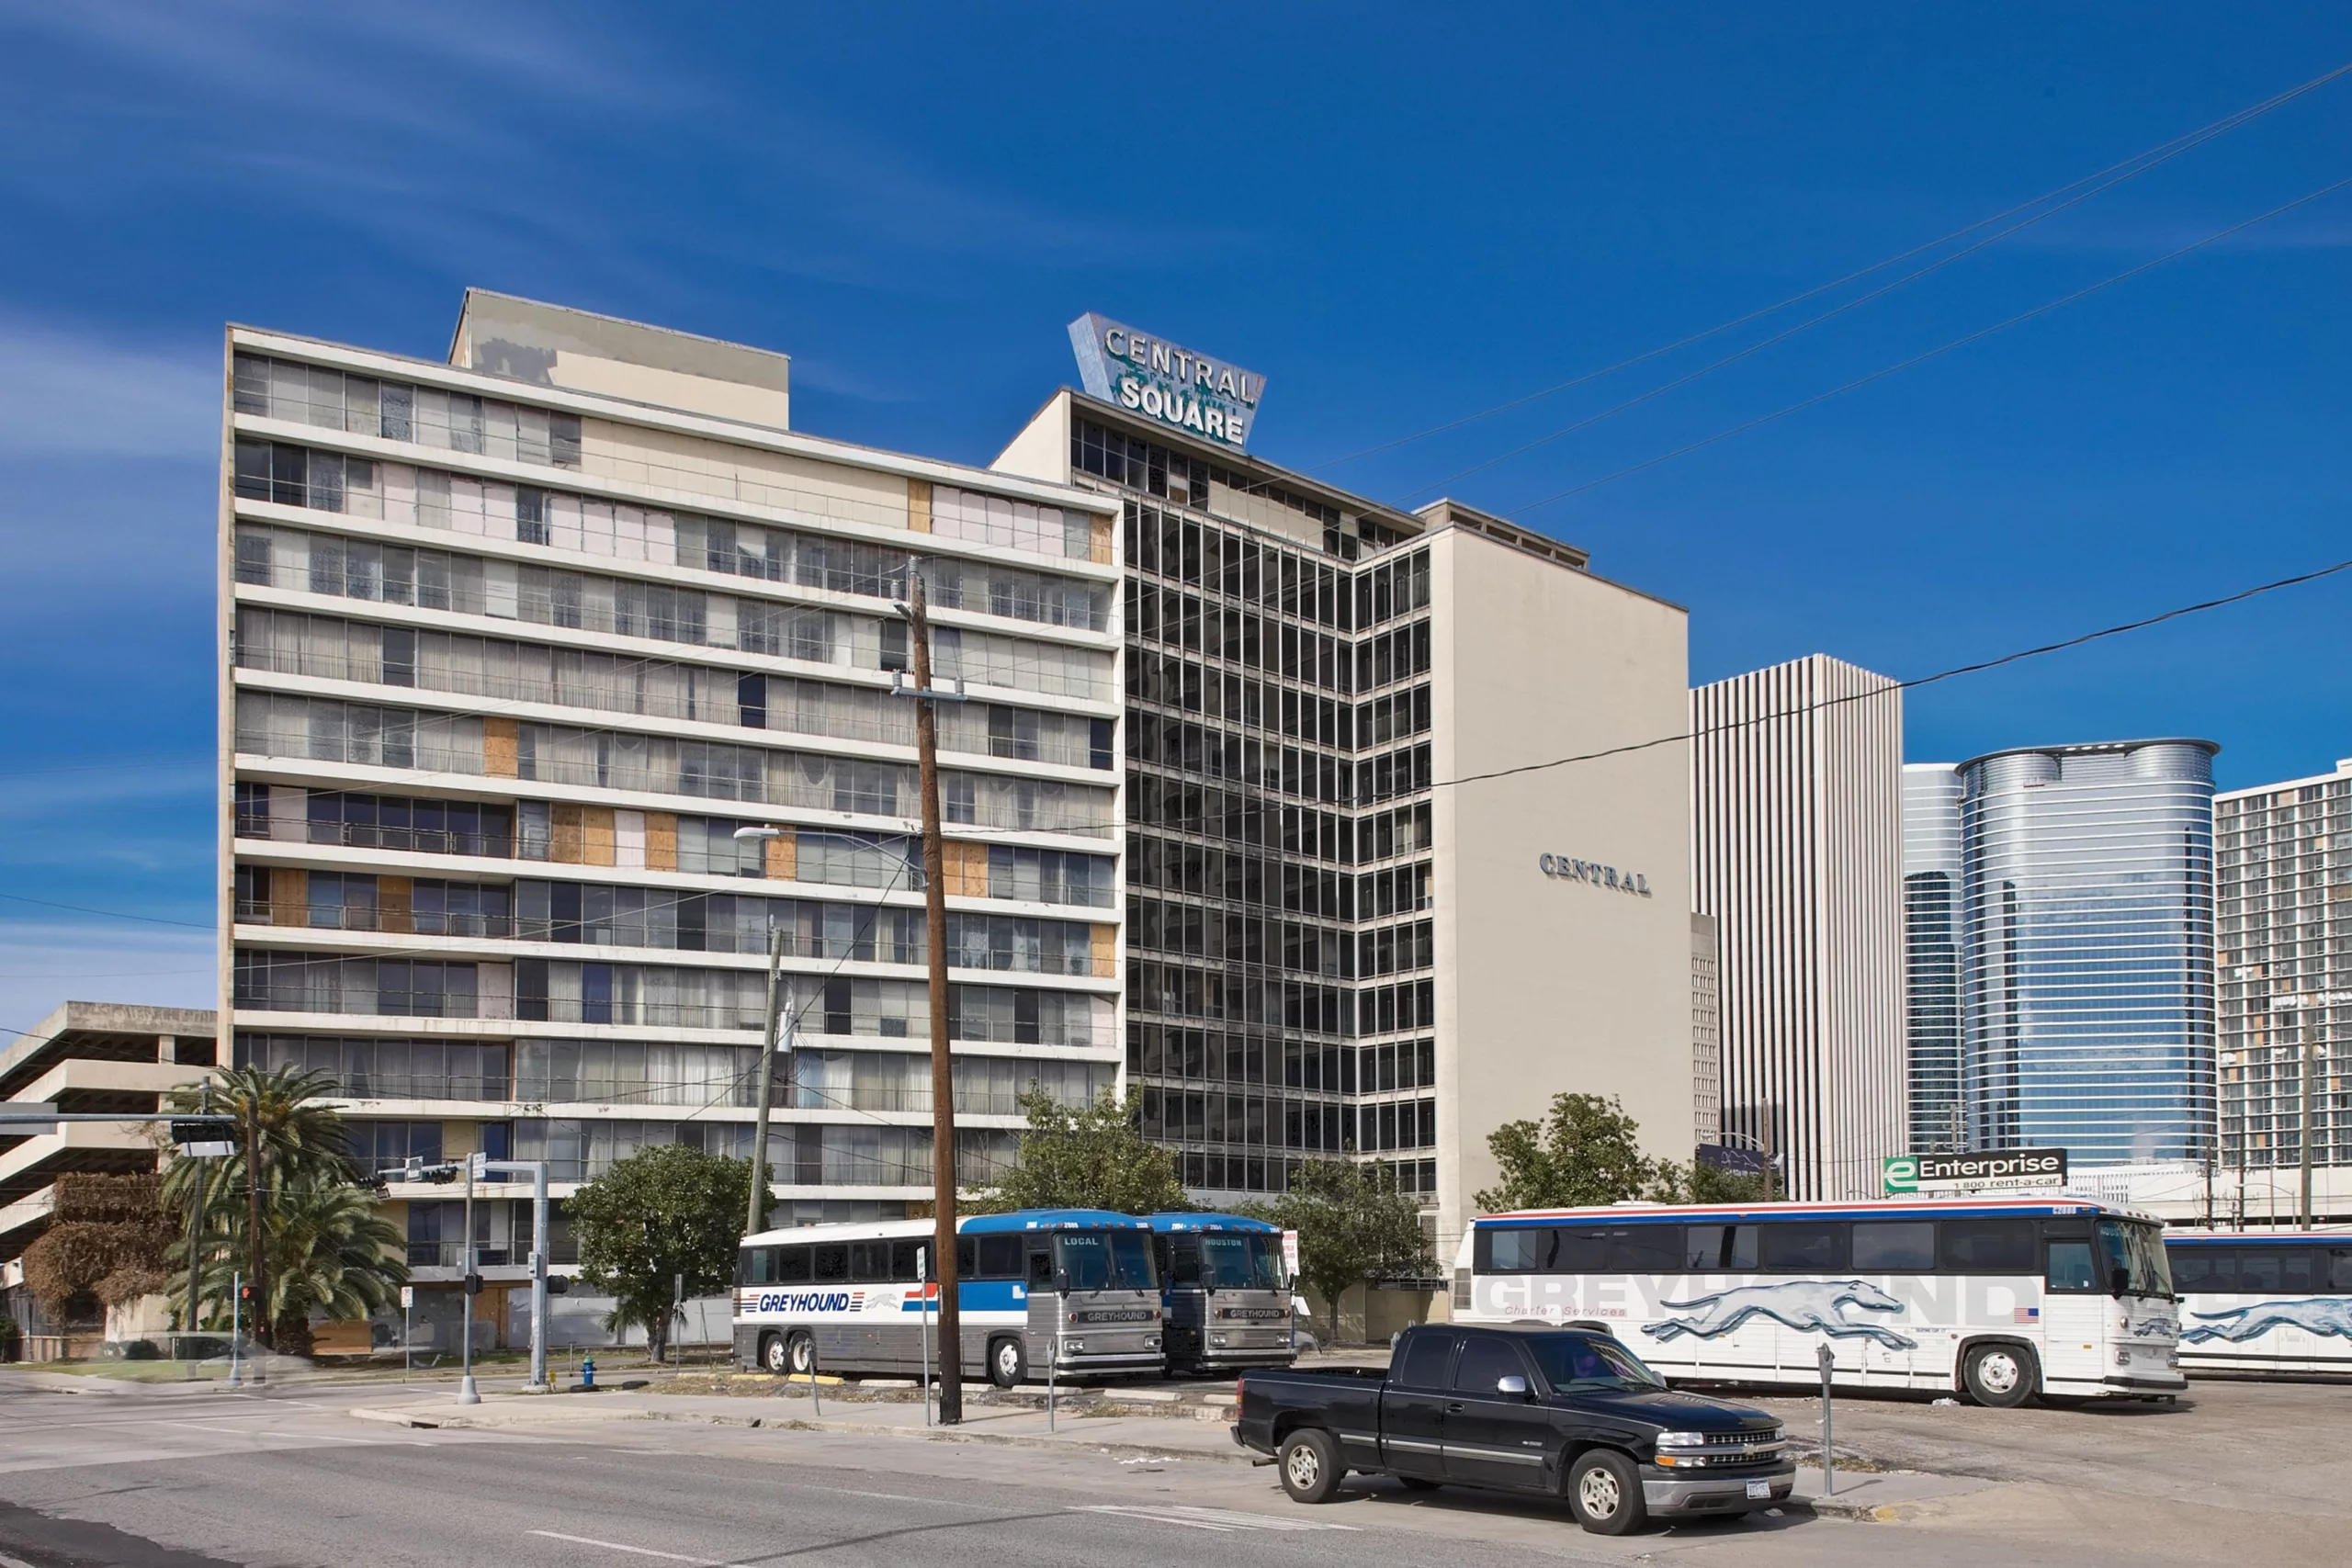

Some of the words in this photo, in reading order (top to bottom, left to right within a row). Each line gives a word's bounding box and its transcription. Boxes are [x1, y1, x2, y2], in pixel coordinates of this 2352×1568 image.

[1104, 327, 1255, 404] CENTRAL
[1120, 376, 1243, 446] SQUARE
[1539, 852, 1652, 896] CENTRAL
[1919, 1153, 2060, 1179] Enterprise
[1962, 1180, 1985, 1189] 800
[1989, 1177, 2060, 1188] rent-a-car
[1064, 1236, 1099, 1246] LOCAL
[1204, 1238, 1242, 1247] HOUSTON
[759, 1292, 850, 1313] GREYHOUND
[1476, 1275, 2040, 1327] GREYHND
[1087, 1311, 1148, 1322] GREYHOUND
[1229, 1309, 1280, 1318] GREYHOUND
[1504, 1305, 1555, 1315] Charter
[1563, 1306, 1626, 1316] Services
